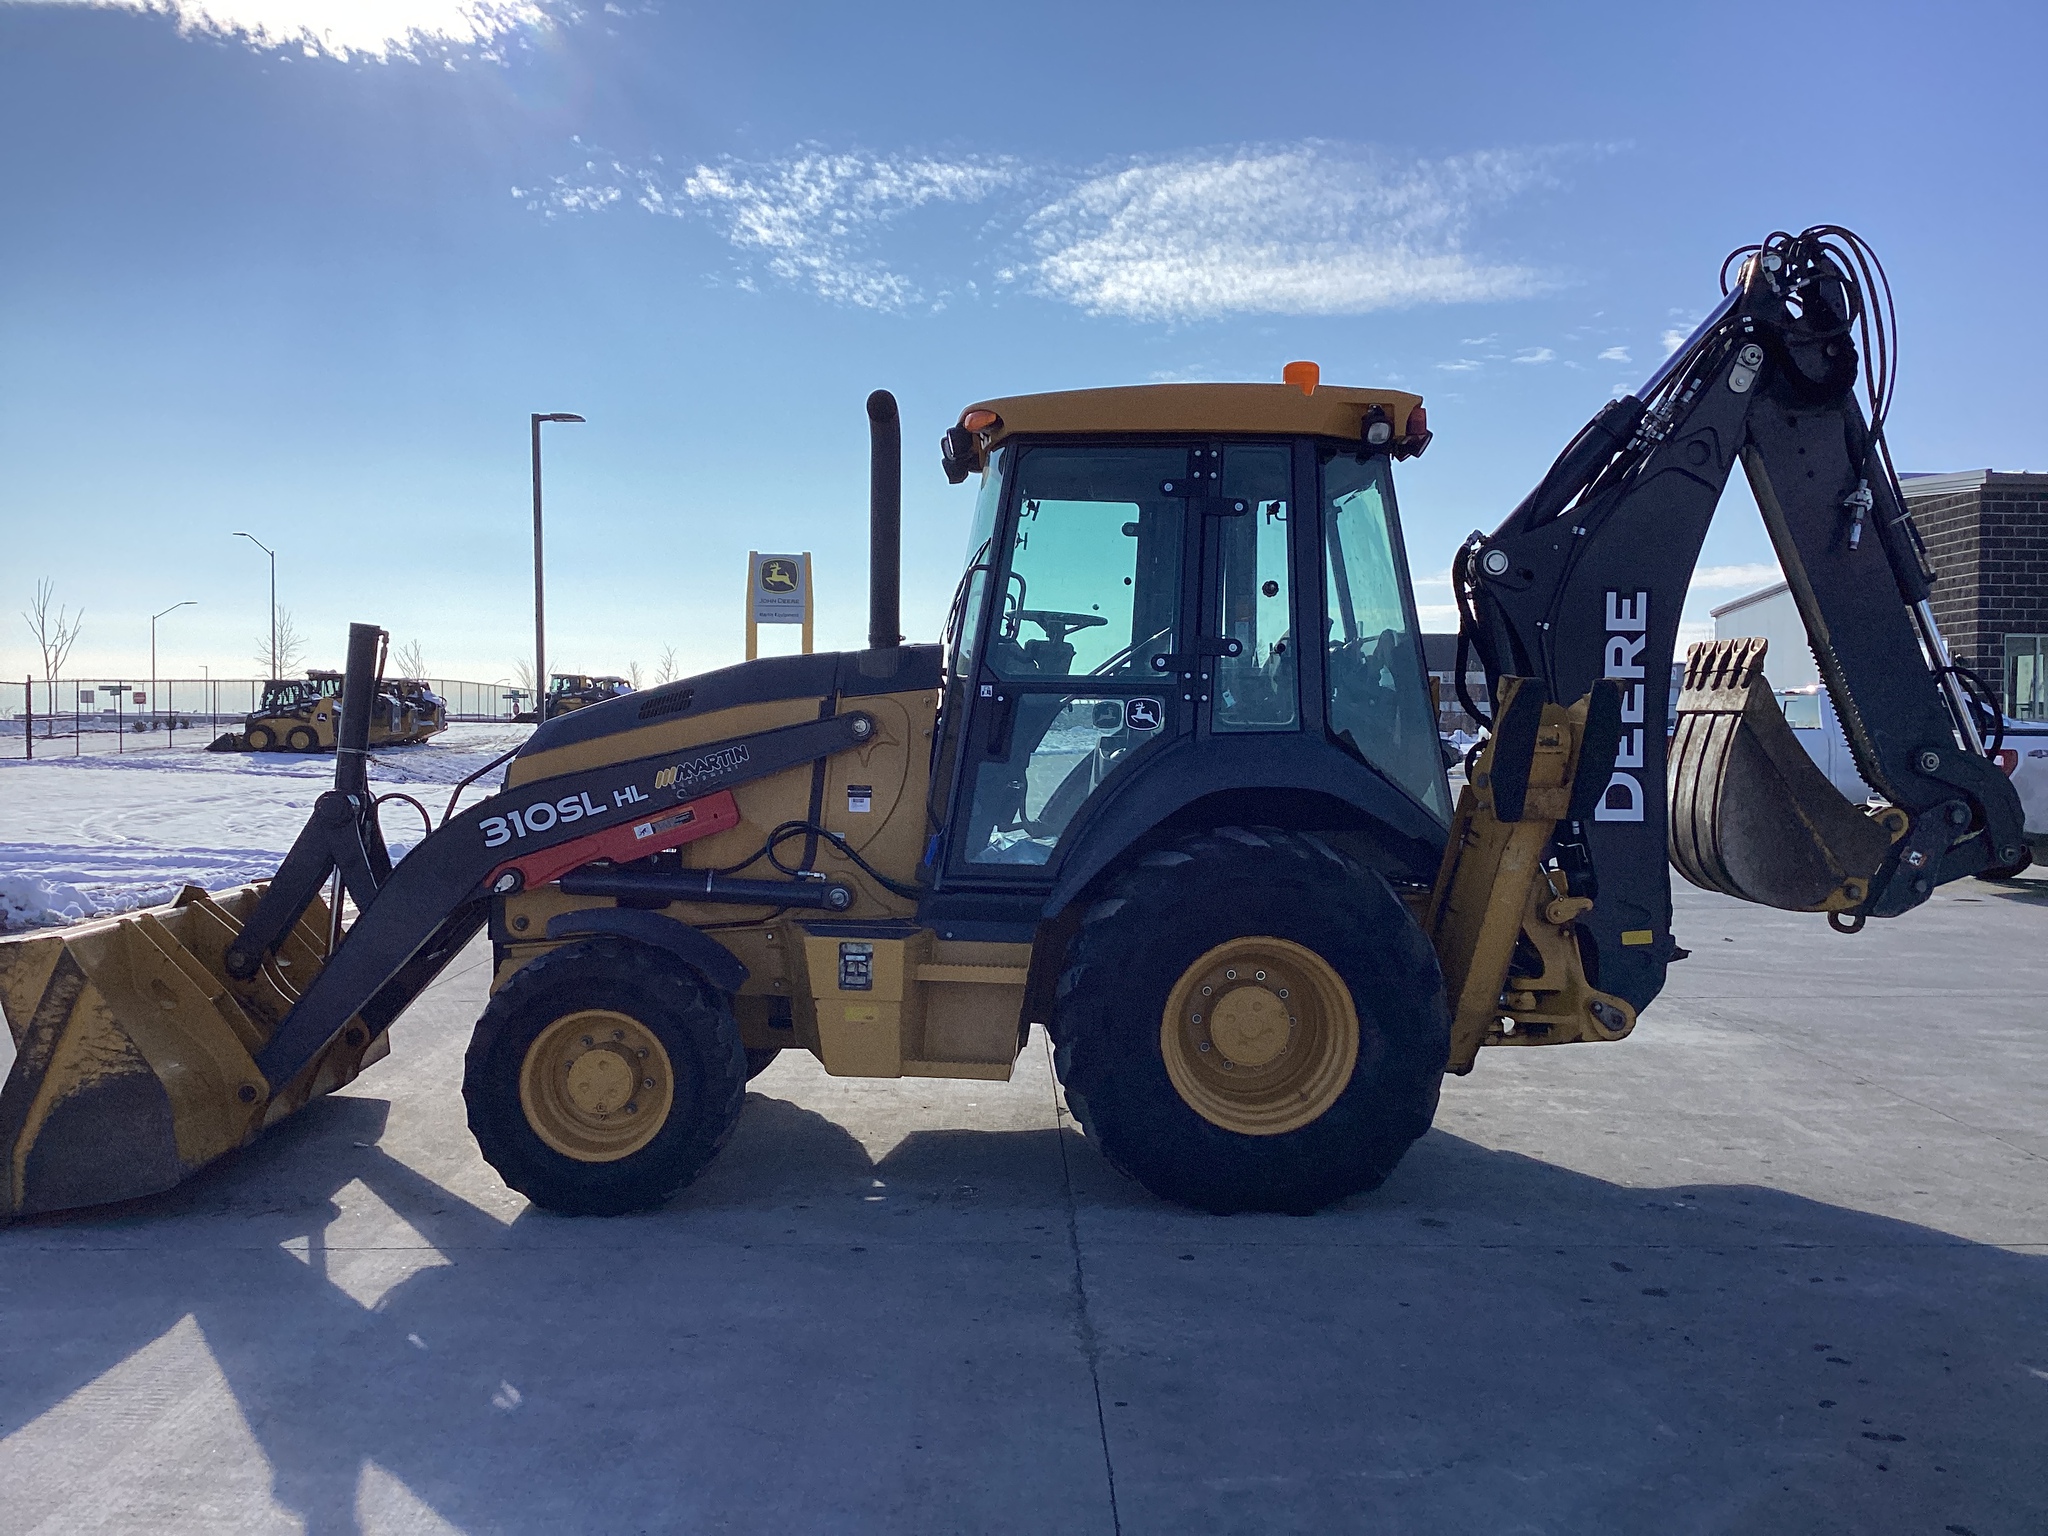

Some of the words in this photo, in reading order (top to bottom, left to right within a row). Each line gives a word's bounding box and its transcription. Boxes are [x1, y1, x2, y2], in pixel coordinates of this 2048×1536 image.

[1594, 591, 1647, 821] DEERE
[674, 744, 750, 783] MARTIN
[478, 791, 608, 847] 310SL
[612, 785, 649, 808] HL
